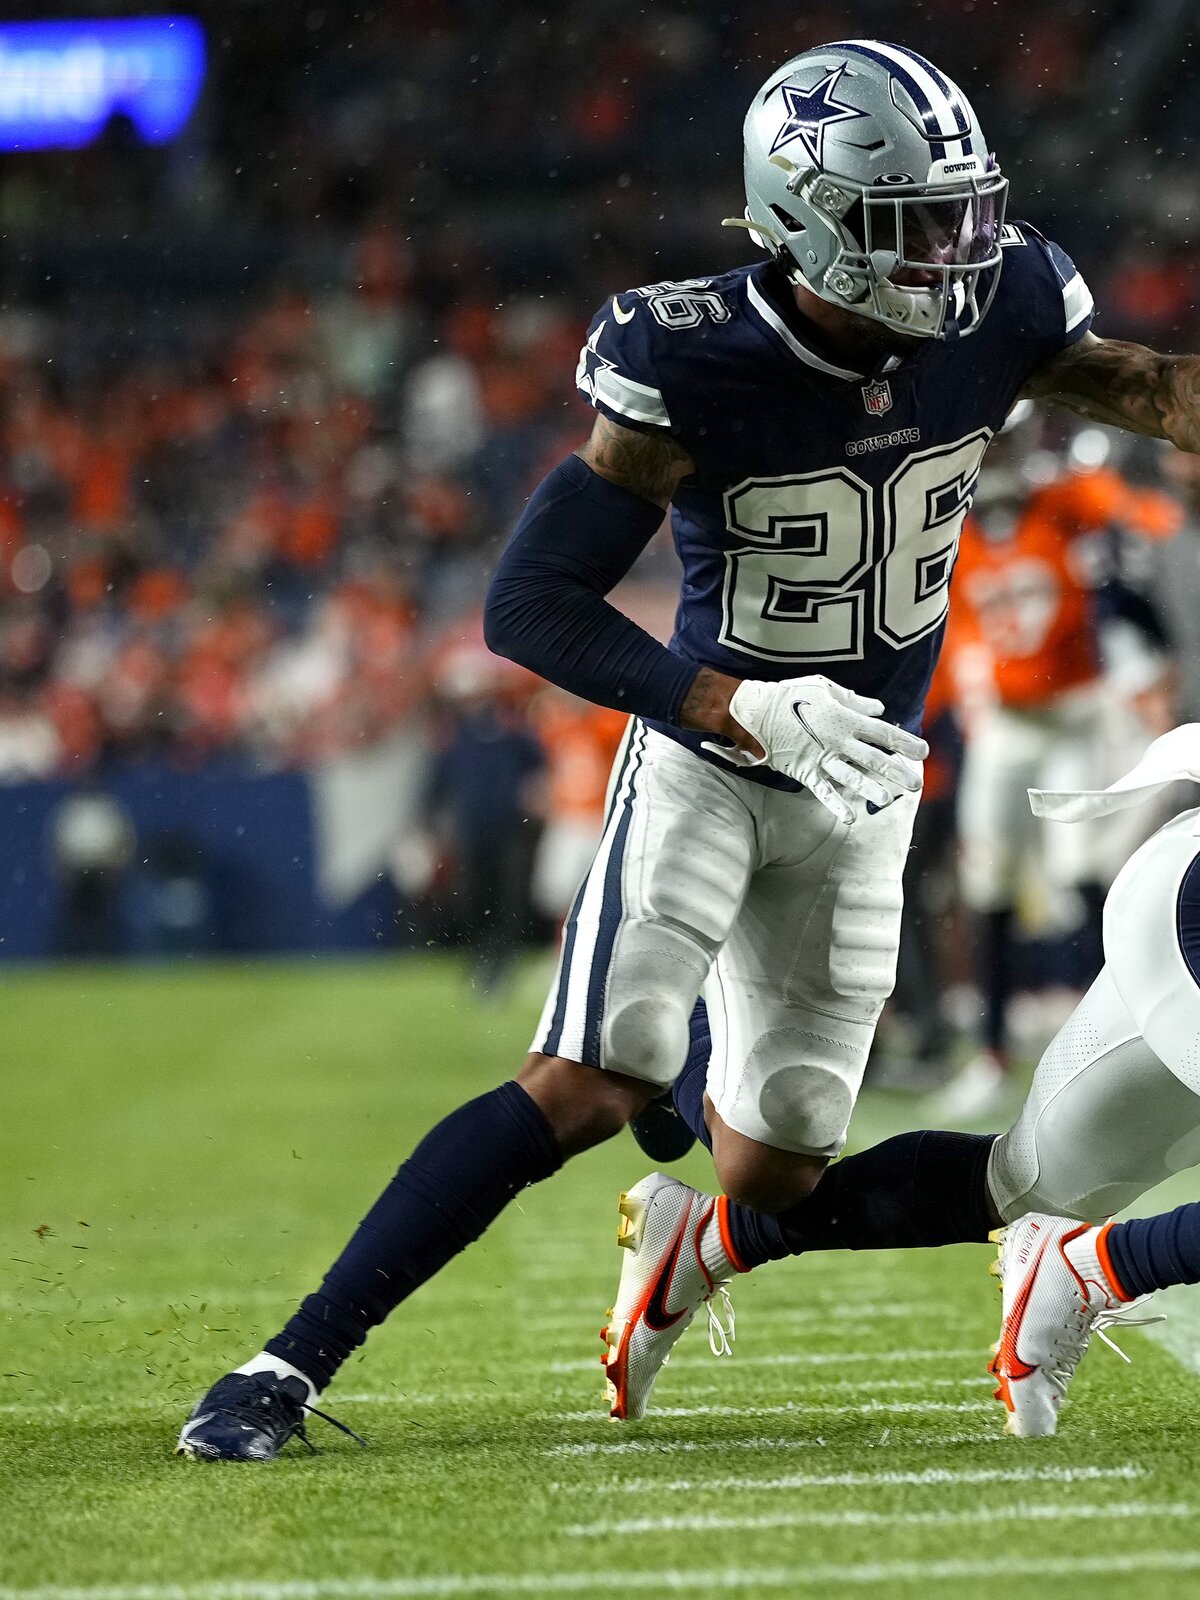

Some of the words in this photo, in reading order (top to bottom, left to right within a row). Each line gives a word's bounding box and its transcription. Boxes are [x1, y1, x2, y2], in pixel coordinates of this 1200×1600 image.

[943, 161, 977, 174] COWBOYS
[868, 393, 891, 411] NFL
[845, 427, 921, 457] COWBOYS
[717, 425, 994, 663] 26
